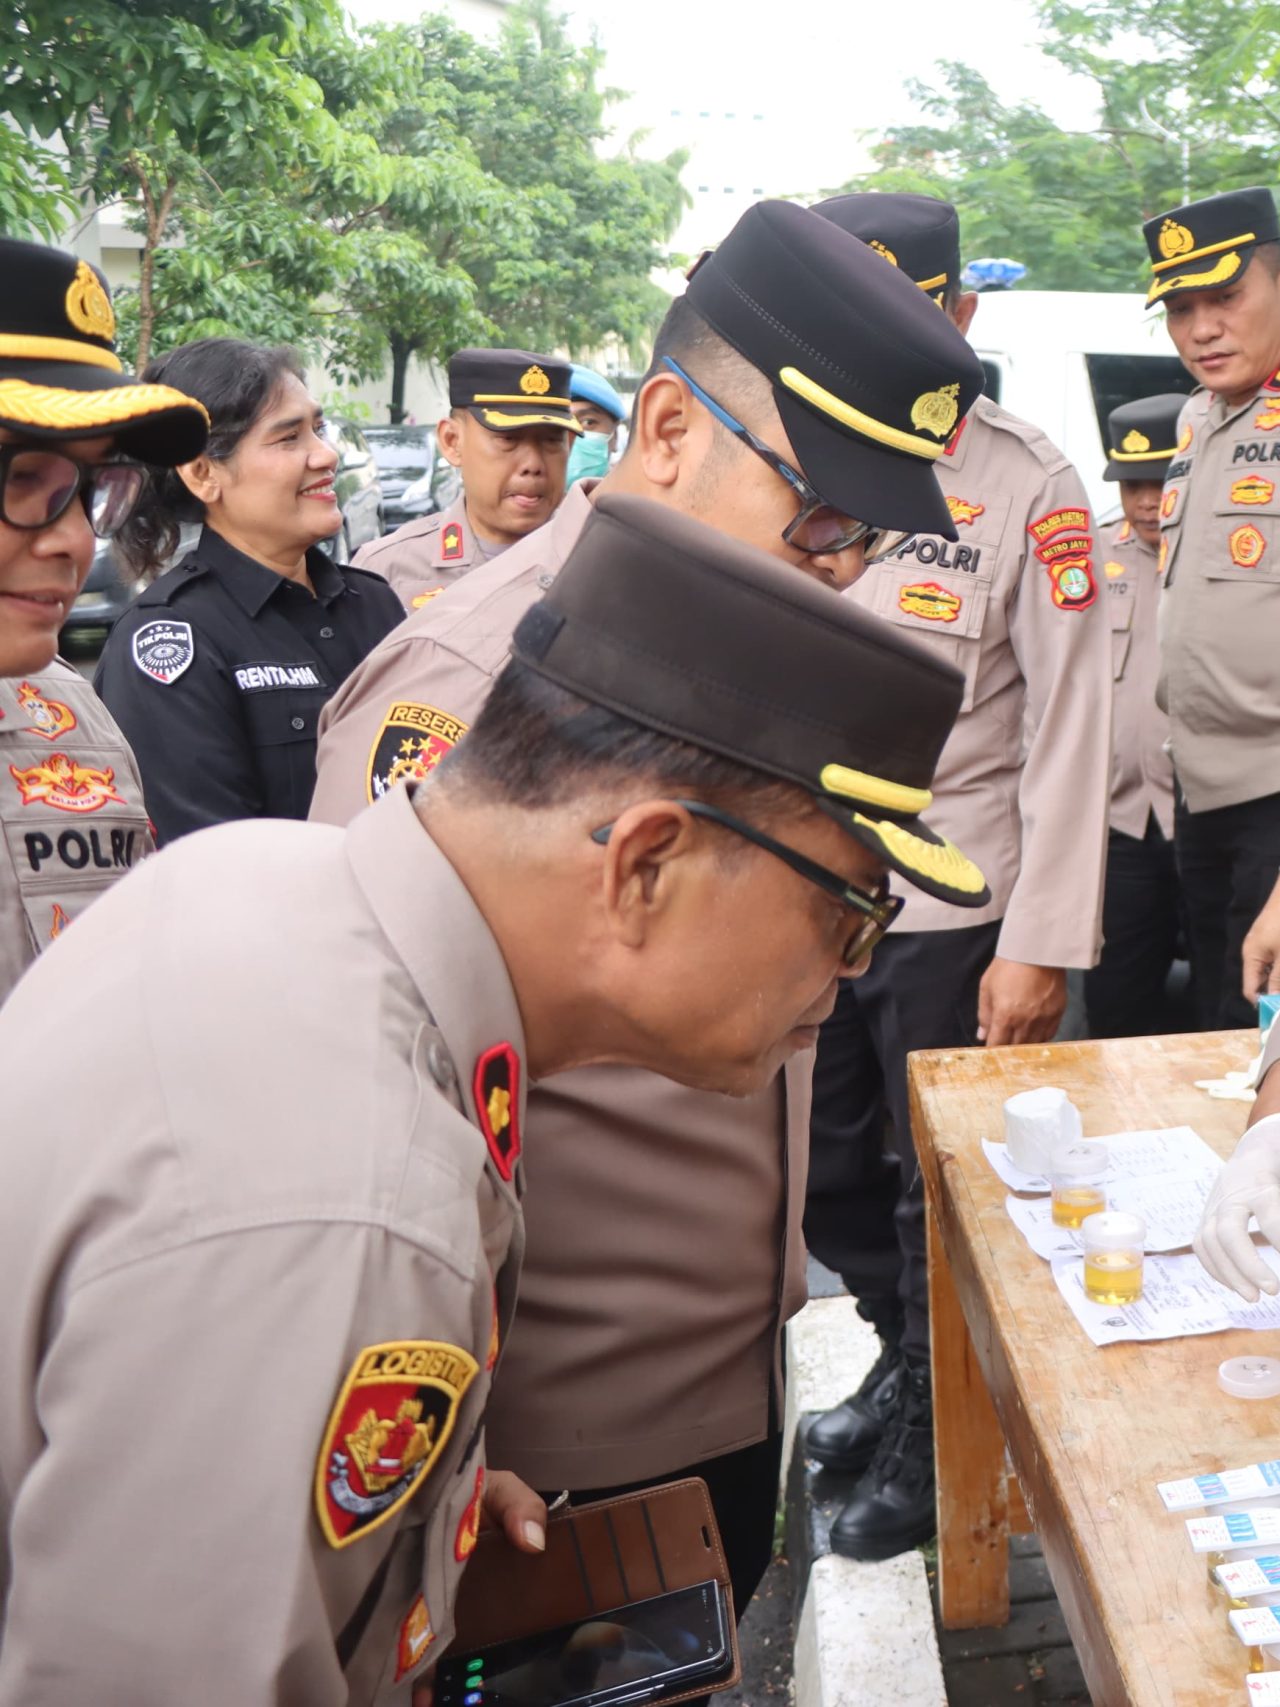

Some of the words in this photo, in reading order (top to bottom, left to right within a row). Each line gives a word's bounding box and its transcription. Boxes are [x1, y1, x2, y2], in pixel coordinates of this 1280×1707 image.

[1042, 543, 1069, 558] METRO
[1070, 540, 1088, 550] JAYA
[25, 829, 135, 872] POLRI
